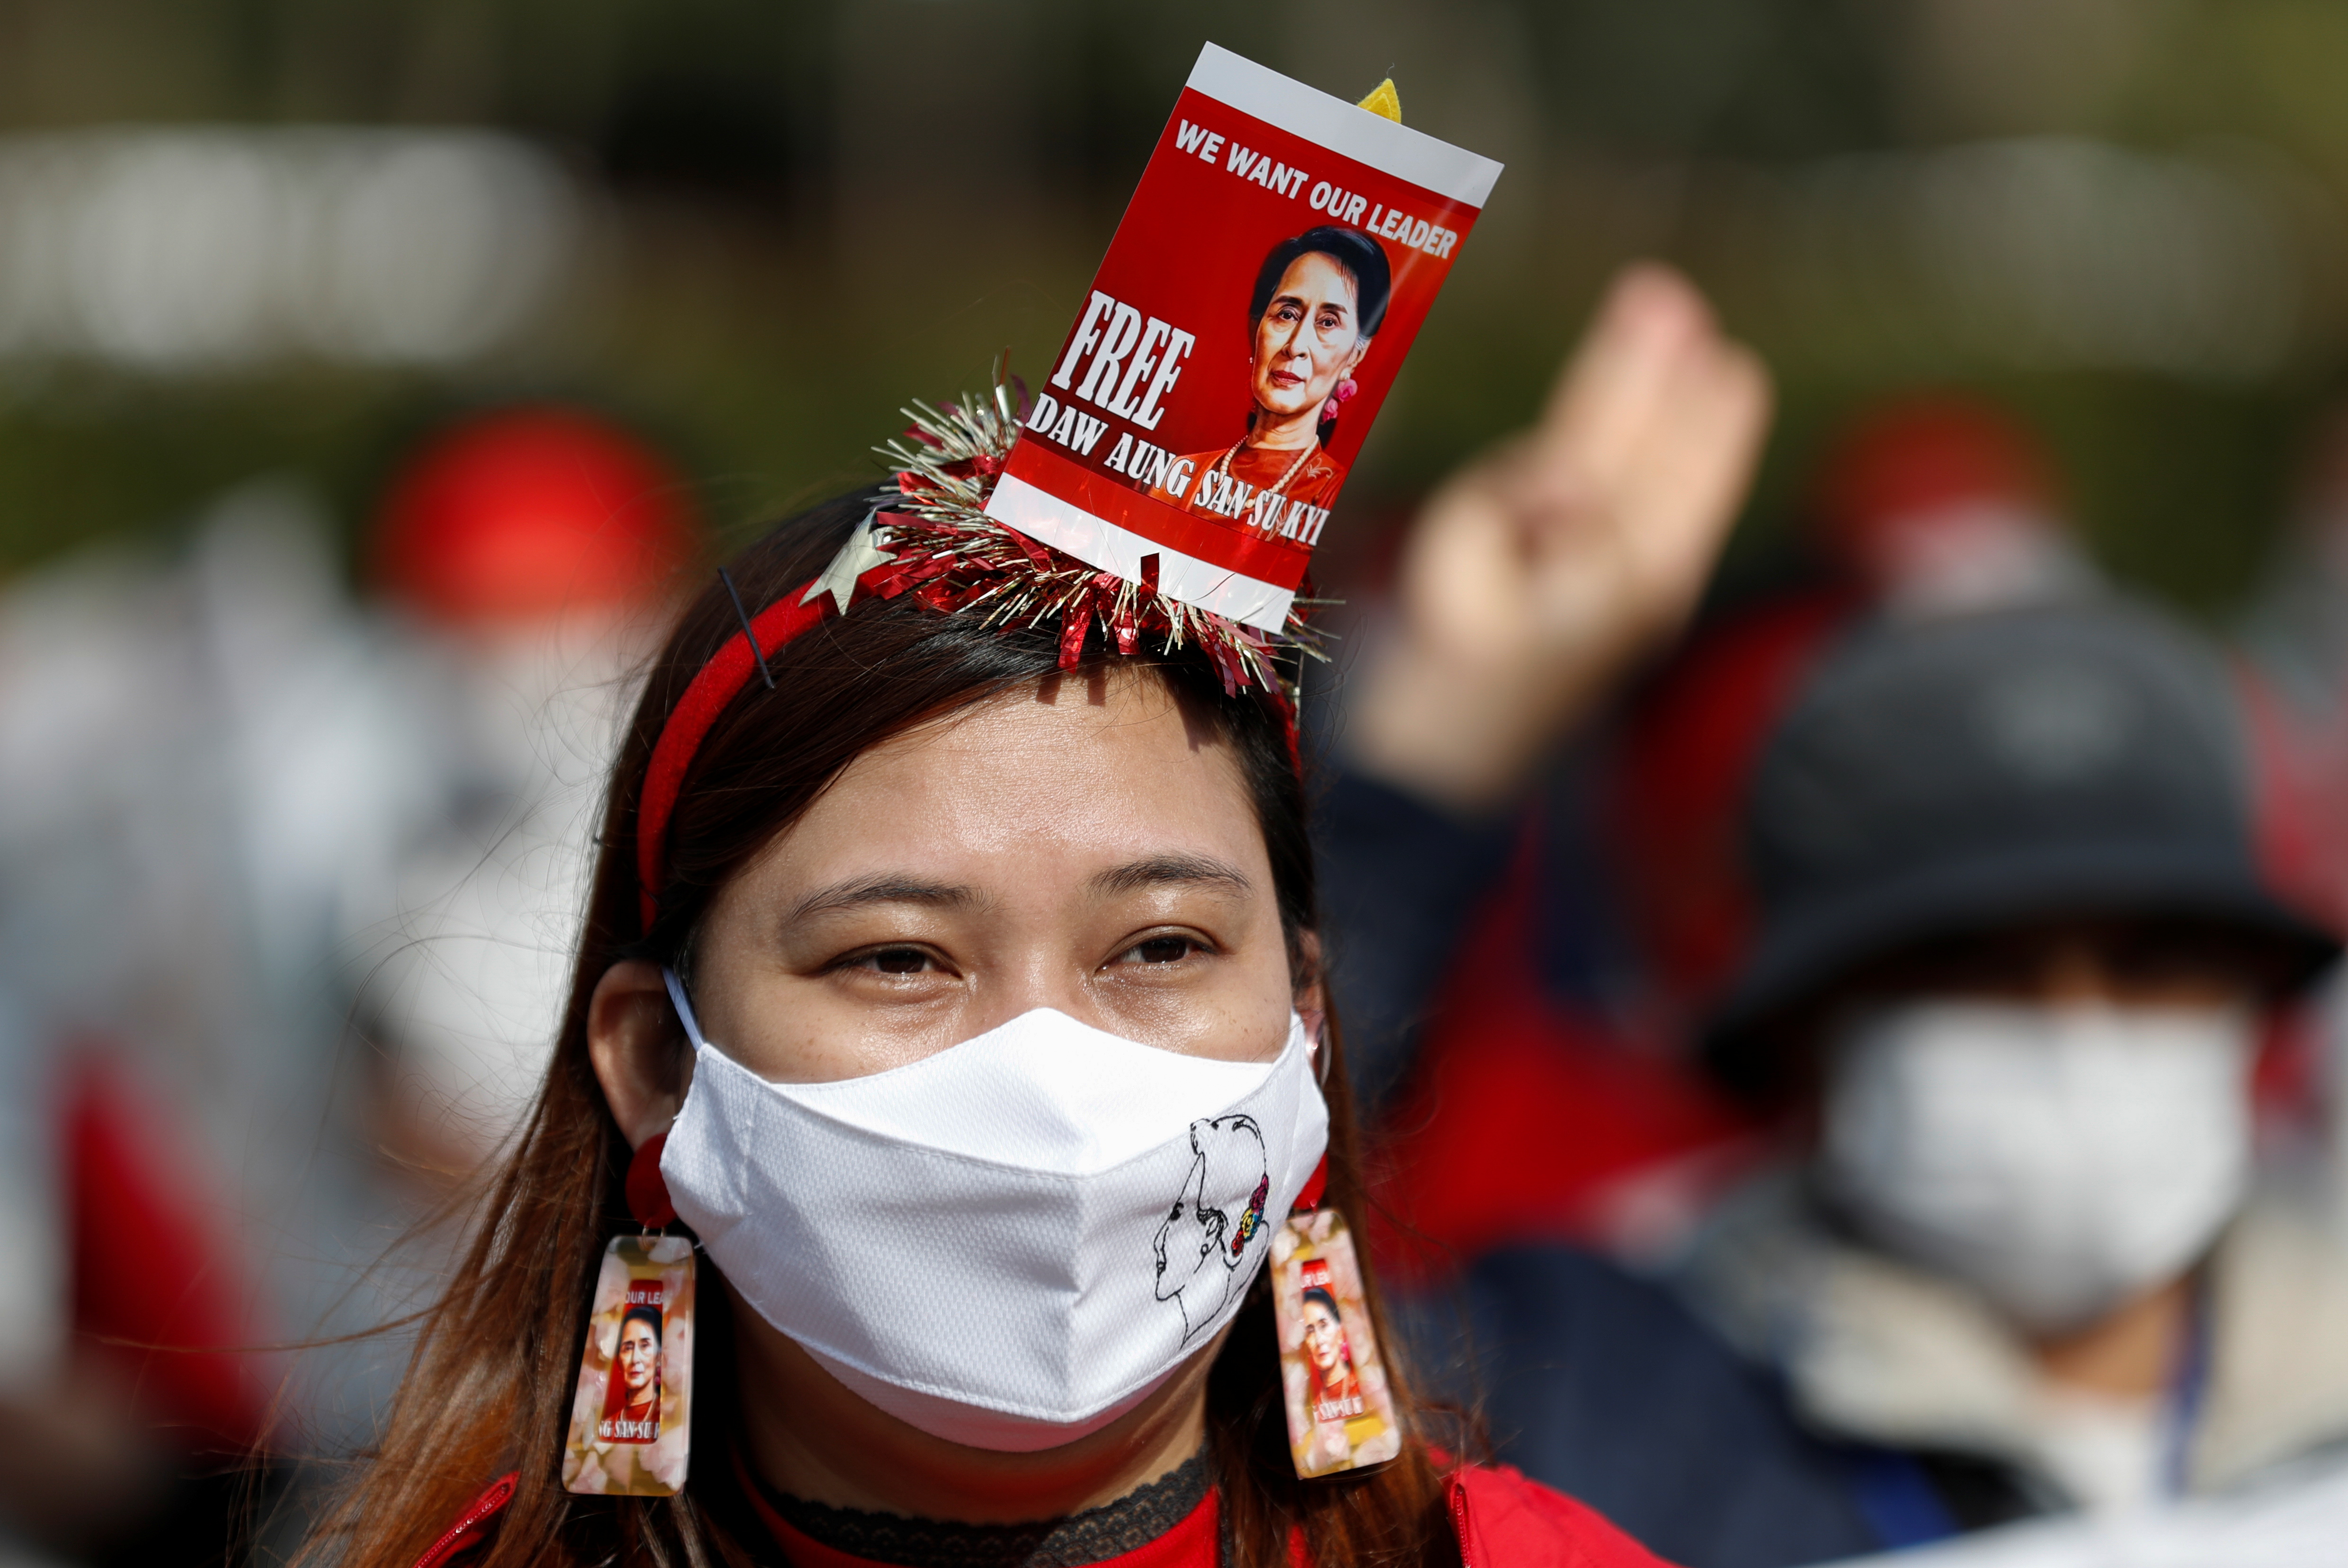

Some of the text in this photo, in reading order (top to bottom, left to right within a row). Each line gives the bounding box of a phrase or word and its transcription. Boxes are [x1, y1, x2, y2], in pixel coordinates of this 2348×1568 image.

[1175, 119, 1458, 259] WE WANT OUR LEADER
[1050, 289, 1196, 431] FREE
[1025, 392, 1331, 546] DAW AUNG SAN SU KYI
